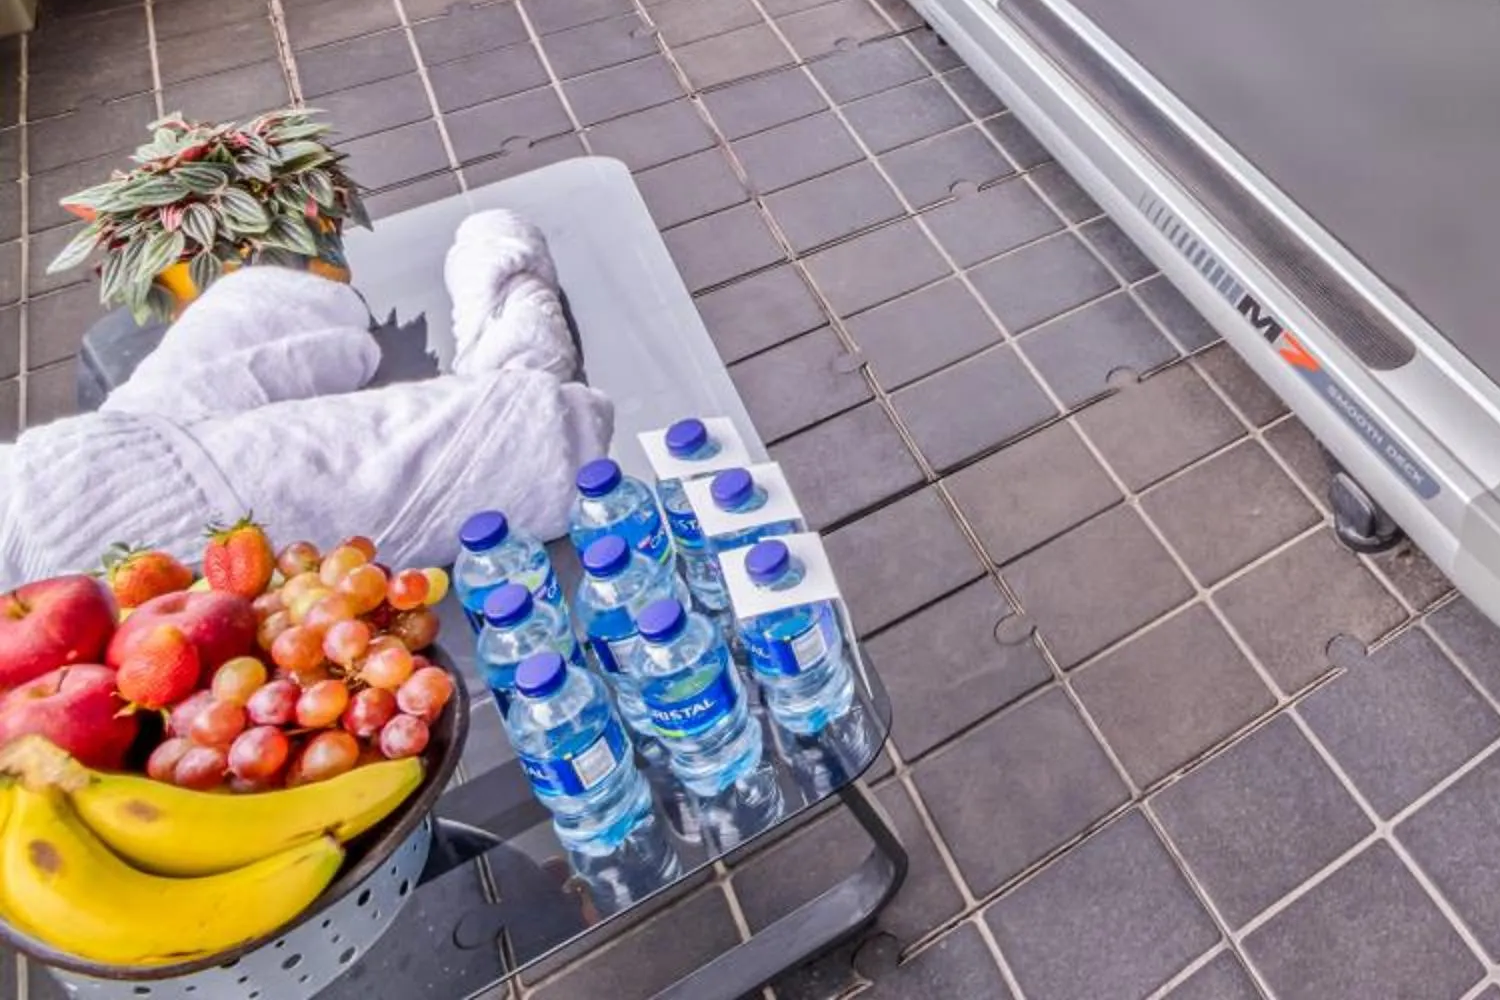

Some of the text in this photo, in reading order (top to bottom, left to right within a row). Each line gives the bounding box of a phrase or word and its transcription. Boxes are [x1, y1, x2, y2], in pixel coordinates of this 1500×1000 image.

[1237, 293, 1321, 374] M7
[1326, 382, 1425, 486] SMOOTH DECK
